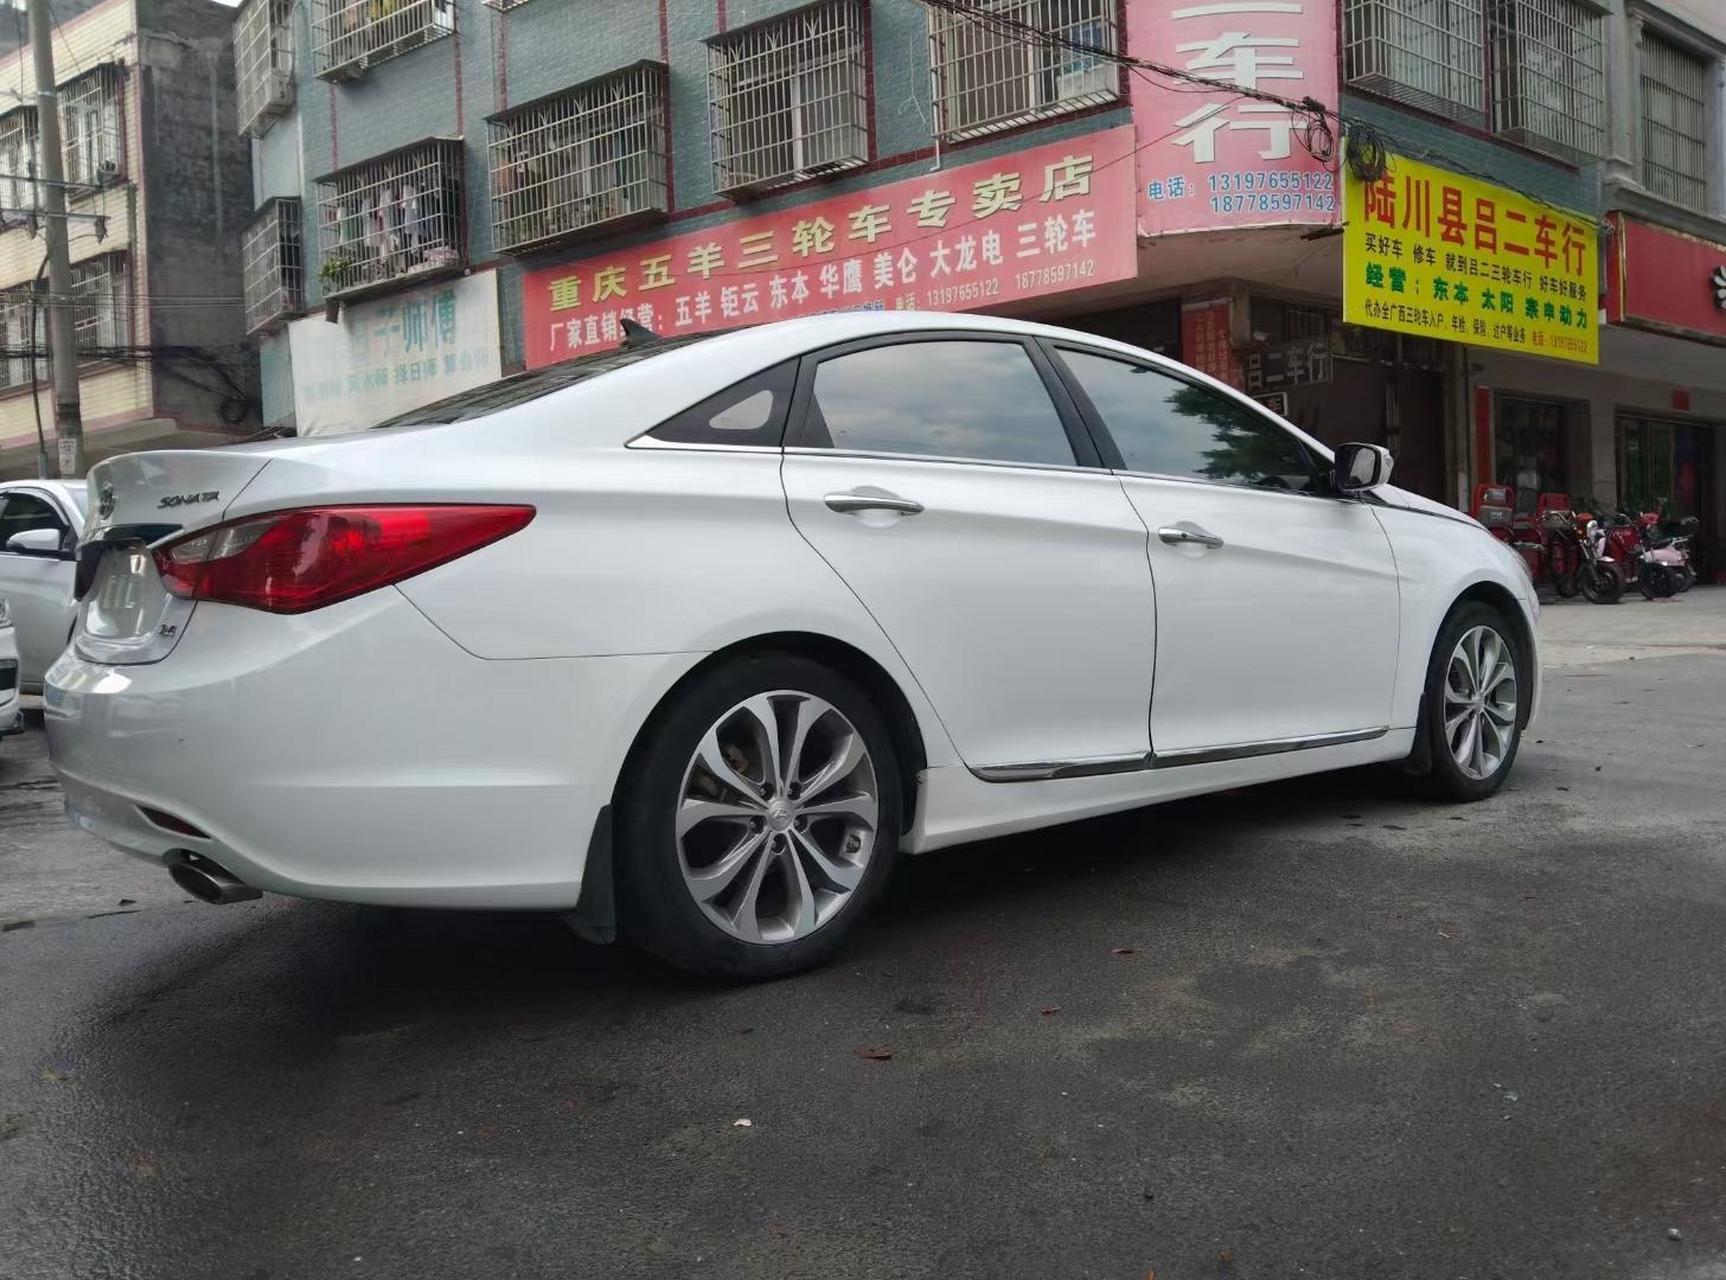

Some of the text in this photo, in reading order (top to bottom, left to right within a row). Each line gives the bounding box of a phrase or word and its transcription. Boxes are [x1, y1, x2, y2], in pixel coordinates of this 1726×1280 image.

[1208, 172, 1334, 192] 13197655122
[1211, 192, 1336, 213] 18778597142
[548, 154, 1094, 313] 重庆五羊三轮车专卖店
[1363, 168, 1588, 277] 陆川县吕二车行
[675, 291, 713, 328] 五羊
[768, 269, 810, 310] 东本
[819, 256, 863, 300] 华鹰
[1016, 209, 1096, 258] 三轮车
[1015, 258, 1095, 291] 18778597142
[1365, 232, 1403, 259] 买好车
[1412, 243, 1436, 265] 修车
[1444, 251, 1533, 290] 就到吕二三轮车行
